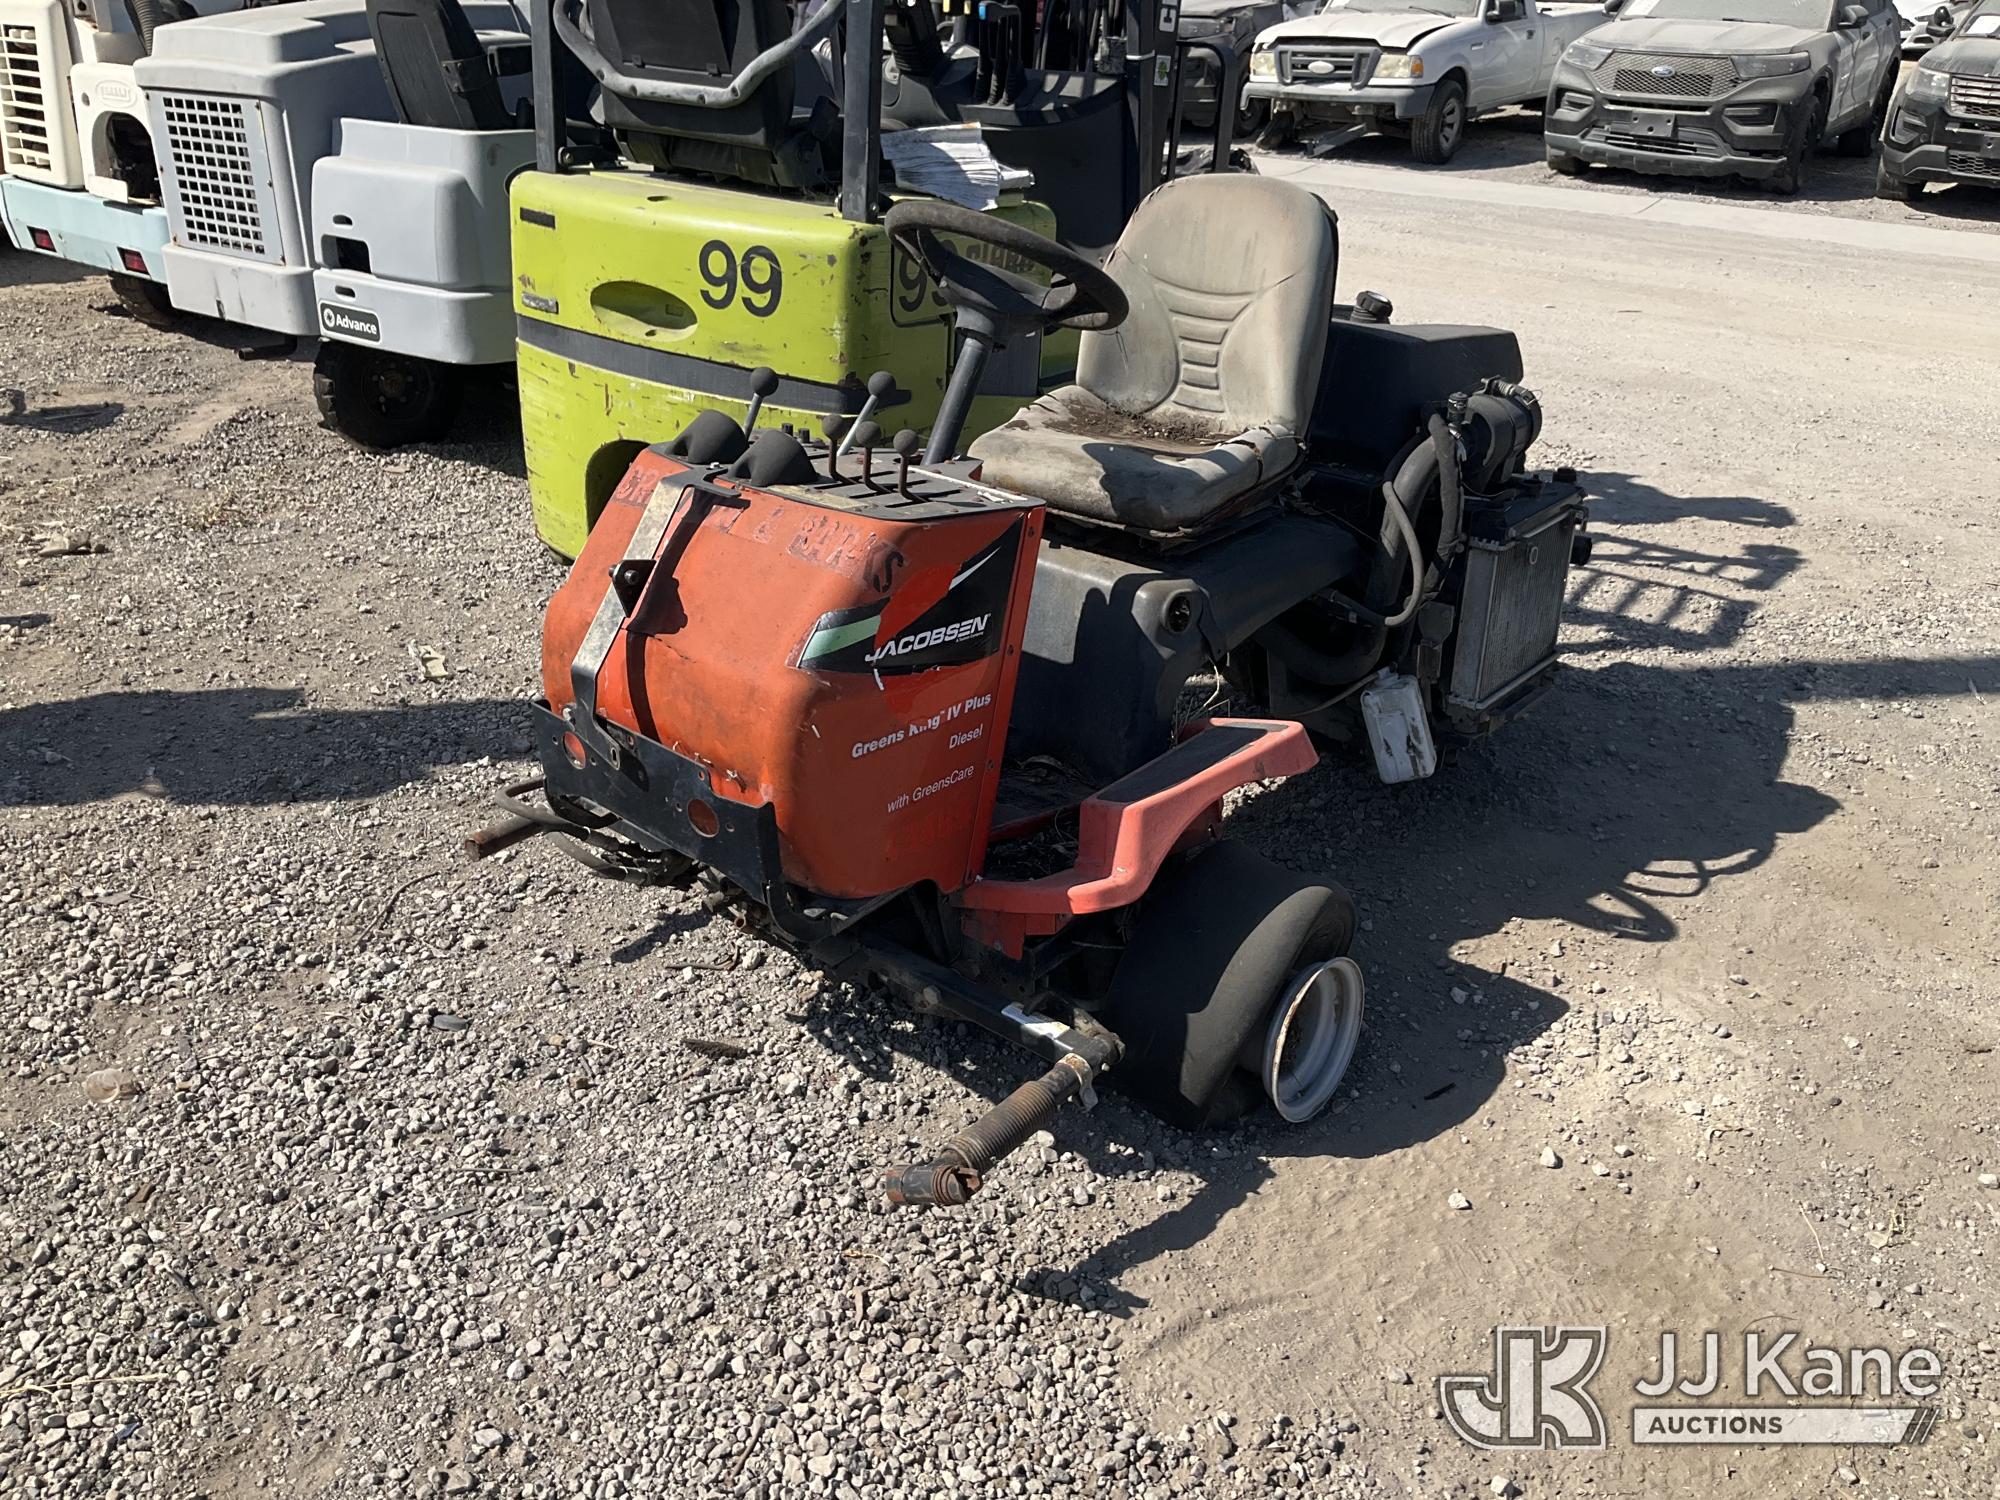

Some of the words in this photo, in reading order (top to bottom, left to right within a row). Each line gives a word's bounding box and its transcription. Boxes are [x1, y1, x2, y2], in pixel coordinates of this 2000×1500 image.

[699, 239, 783, 318] 99
[336, 313, 378, 335] Advance
[864, 613, 990, 662] JACOBSEN
[851, 729, 905, 758] Greens
[909, 715, 941, 737] Kng
[946, 703, 962, 721] IV
[964, 693, 992, 713] Plus
[948, 723, 983, 750] Diesel
[887, 794, 910, 813] with
[912, 765, 975, 802] GreensCare
